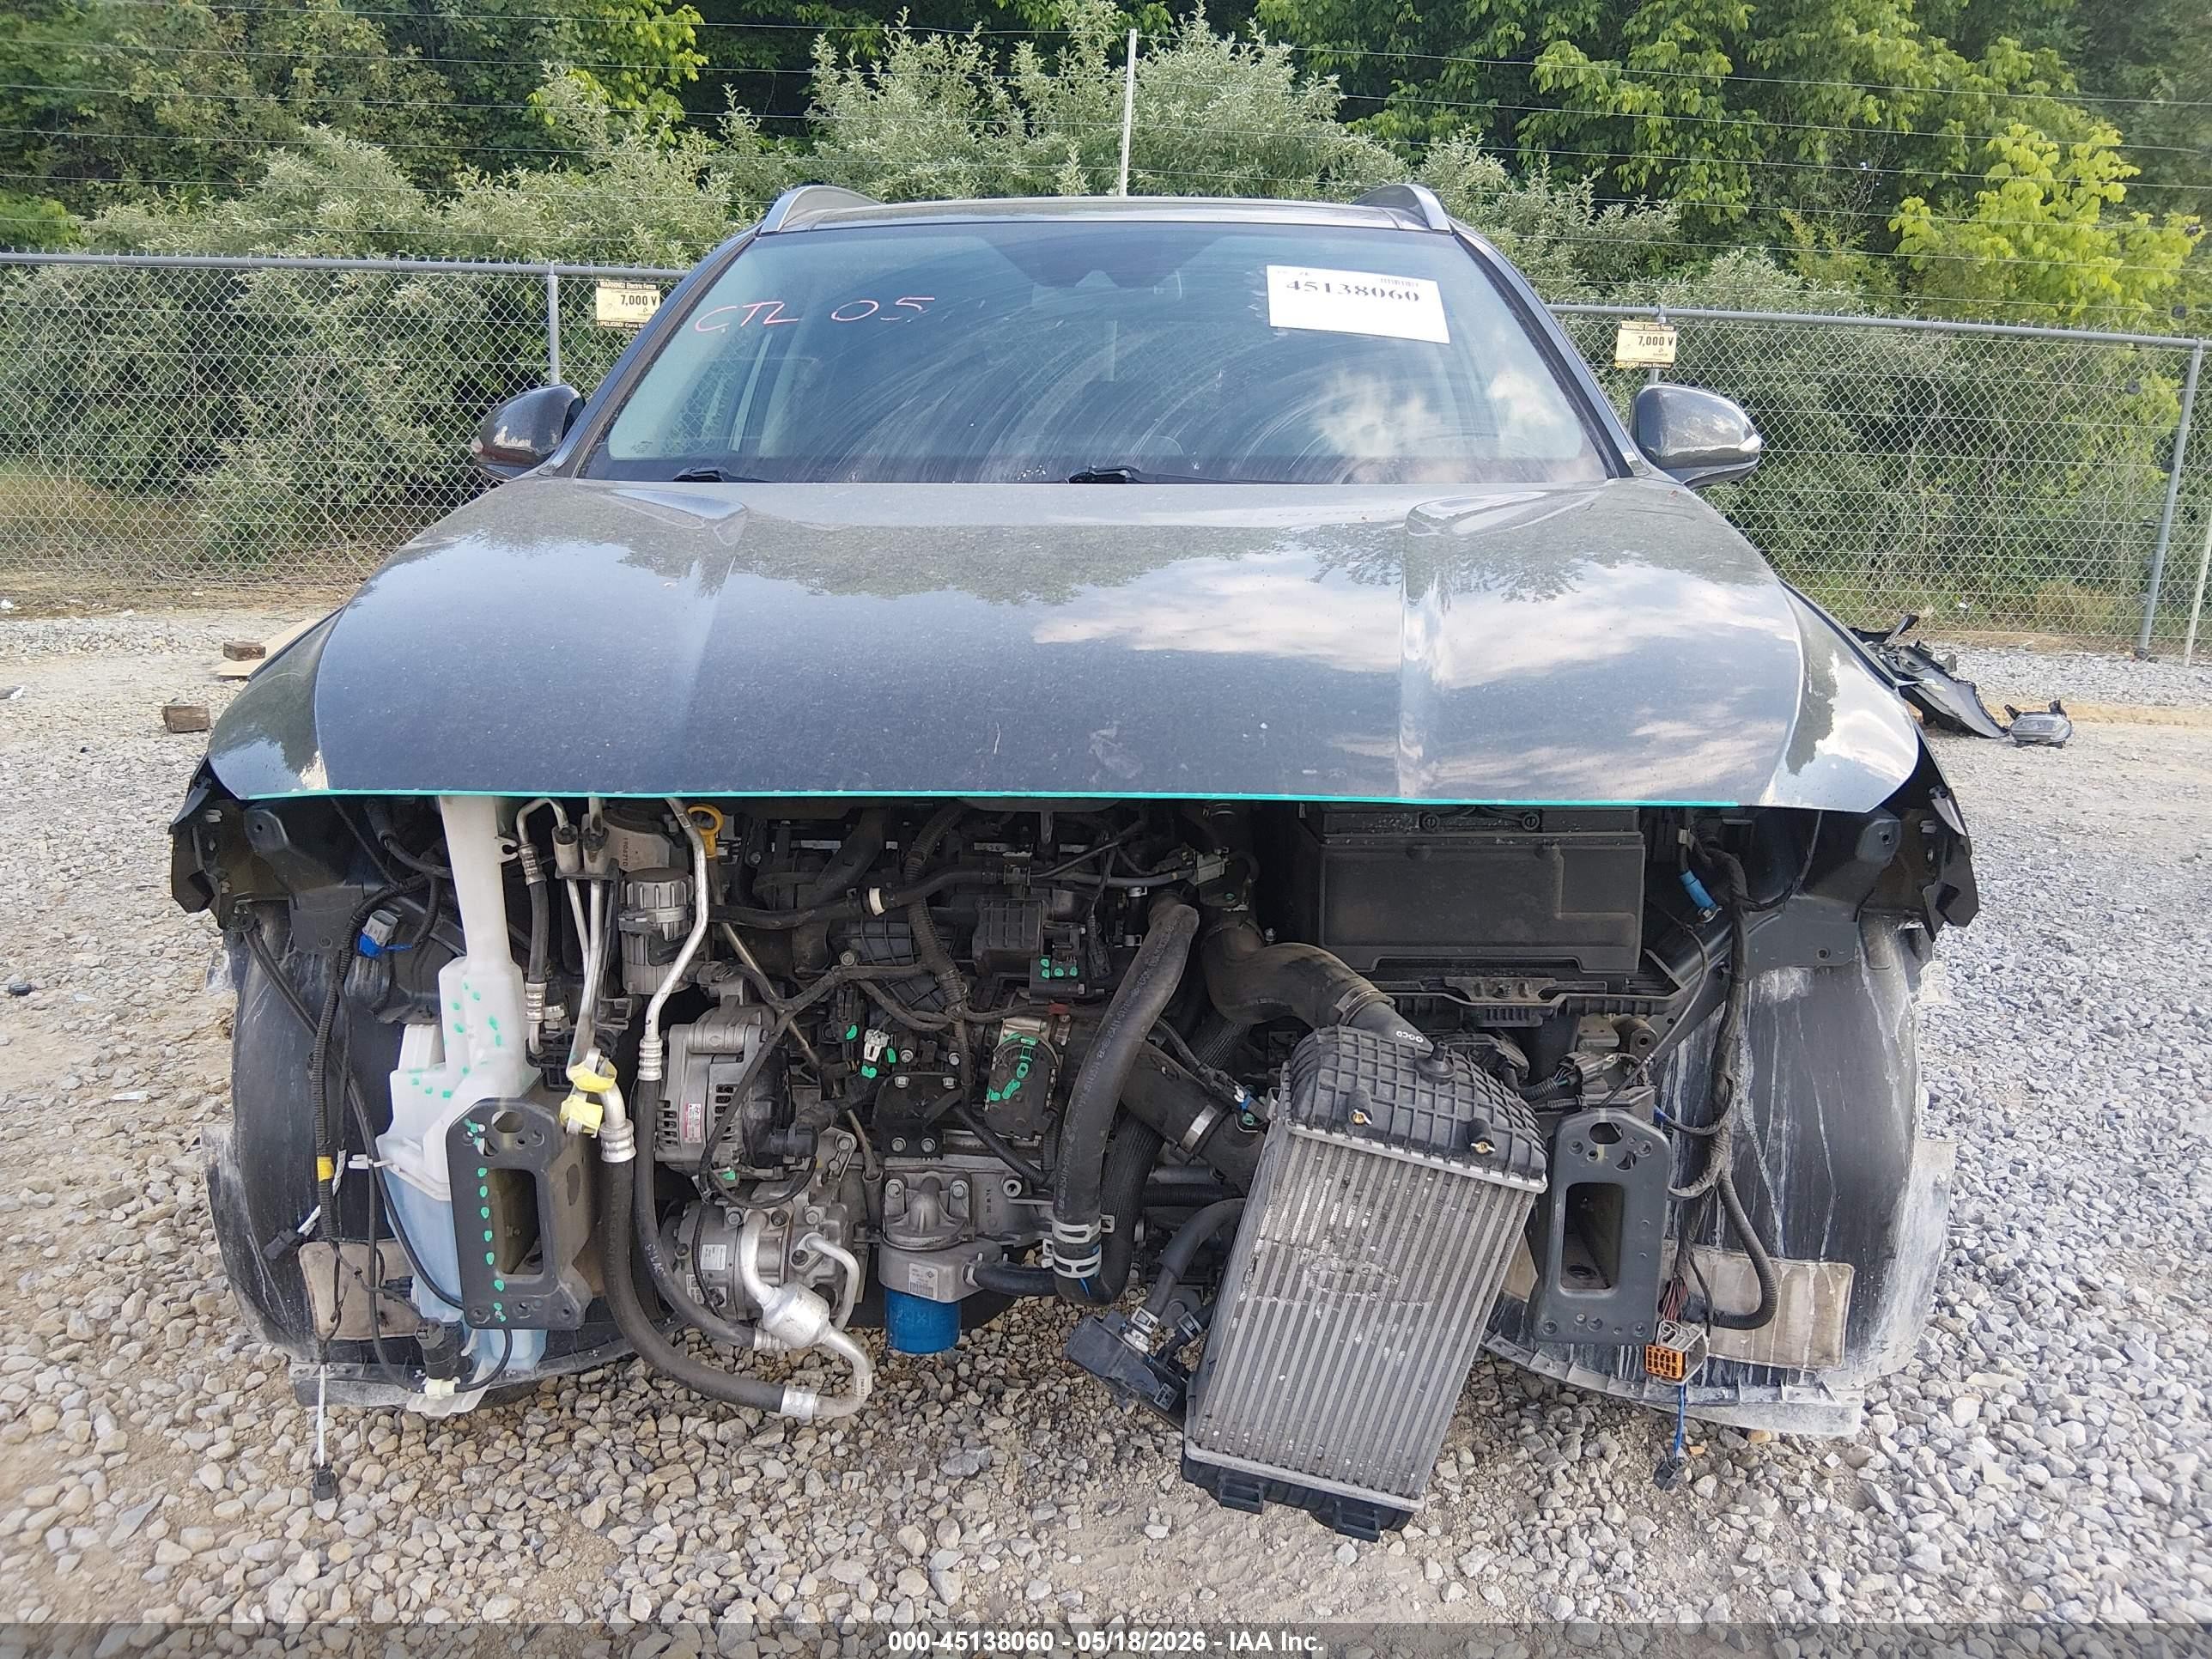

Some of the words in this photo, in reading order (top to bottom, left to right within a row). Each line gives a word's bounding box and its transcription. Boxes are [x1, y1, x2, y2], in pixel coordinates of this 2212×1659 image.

[1286, 279, 1419, 302] 45138060
[621, 295, 647, 307] 7,000
[651, 295, 657, 306] V
[1638, 336, 1665, 348] 7,000
[1668, 336, 1674, 346] V
